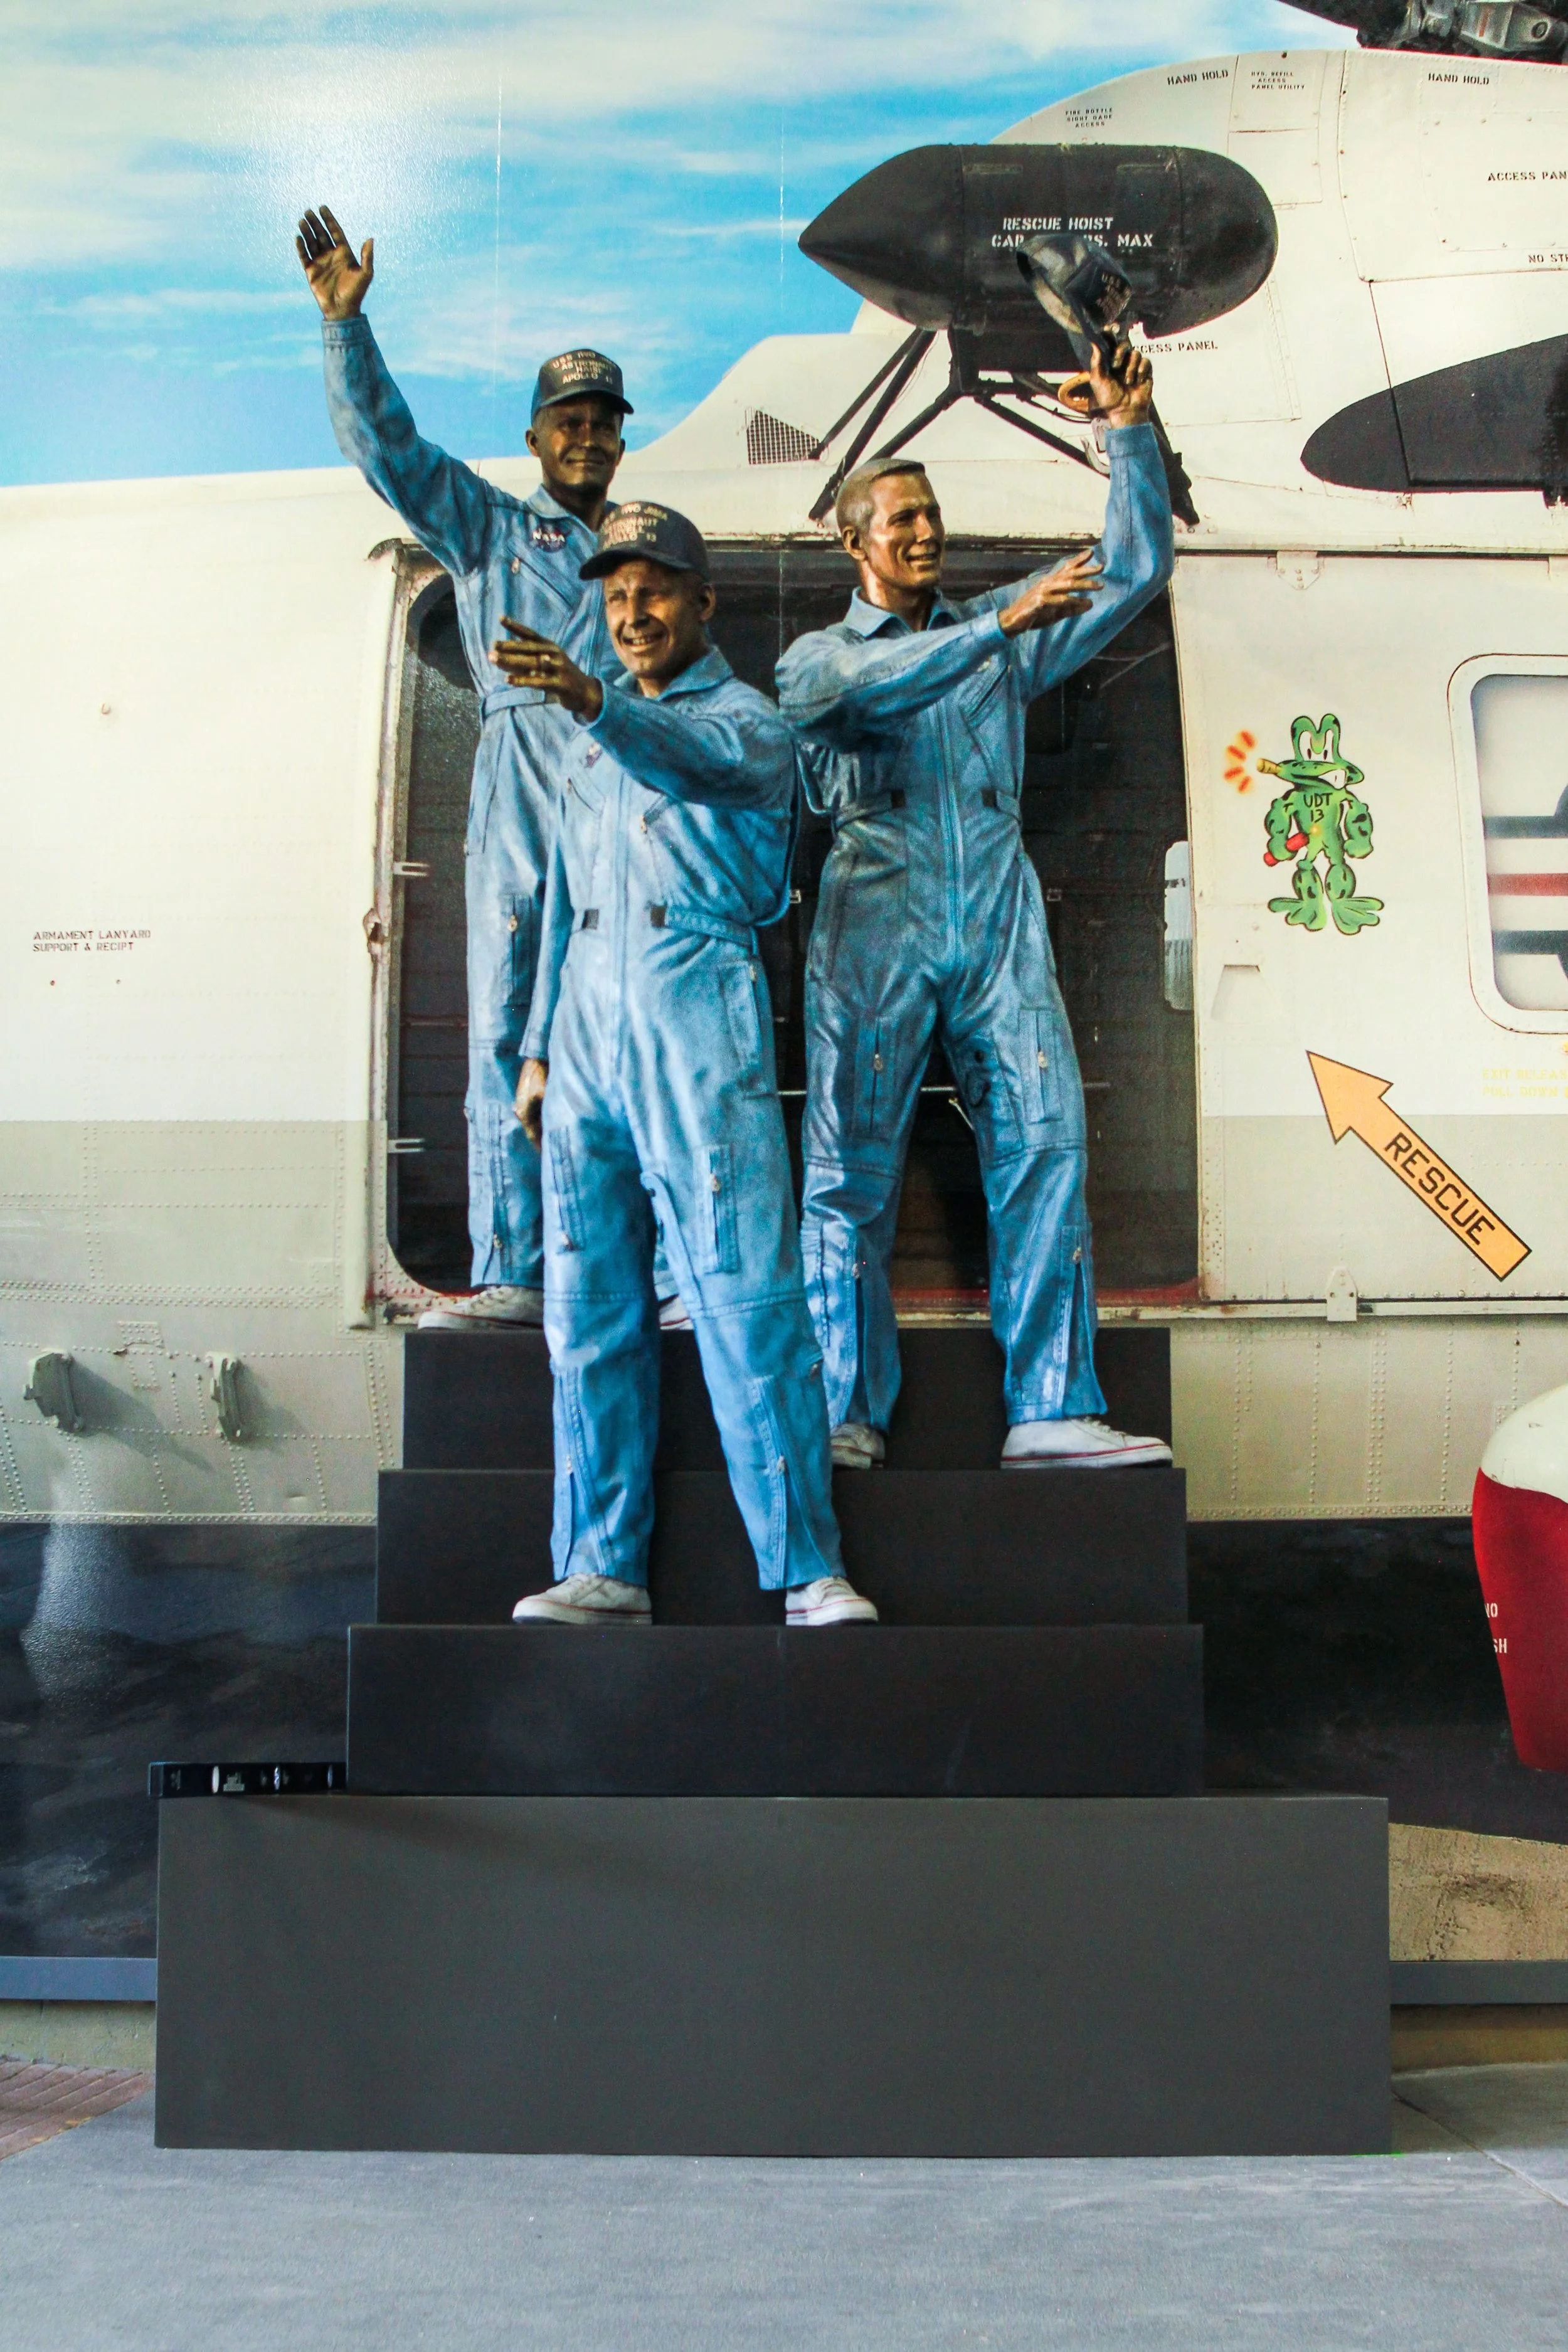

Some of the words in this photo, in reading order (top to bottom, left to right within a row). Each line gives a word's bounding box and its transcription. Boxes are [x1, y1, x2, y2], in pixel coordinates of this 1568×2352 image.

[1167, 74, 1197, 85] HAND
[1202, 70, 1229, 80] HOLD
[1428, 73, 1458, 82] HAND
[1463, 75, 1490, 85] HOLD
[1488, 172, 1535, 181] ACCESS
[1542, 171, 1567, 180] PAN
[1003, 218, 1061, 230] RESCUE
[1069, 218, 1113, 230] HOIST
[992, 234, 1024, 247] CAP
[1118, 235, 1153, 247] MAX
[1528, 255, 1544, 263] NO
[1132, 344, 1172, 353] CCESS
[1178, 341, 1218, 351] PANEL
[553, 354, 573, 368] USS
[562, 373, 598, 384] APOLLO
[532, 528, 565, 543] NASA
[1303, 793, 1333, 808] UDT
[1310, 809, 1324, 823] 13
[34, 931, 93, 940] ARMAMENT
[99, 930, 151, 939] LANYARD
[33, 943, 78, 952] SUPPORT
[85, 943, 91, 951] &
[97, 942, 134, 951] RECIPT
[1384, 1131, 1495, 1246] RESCUE
